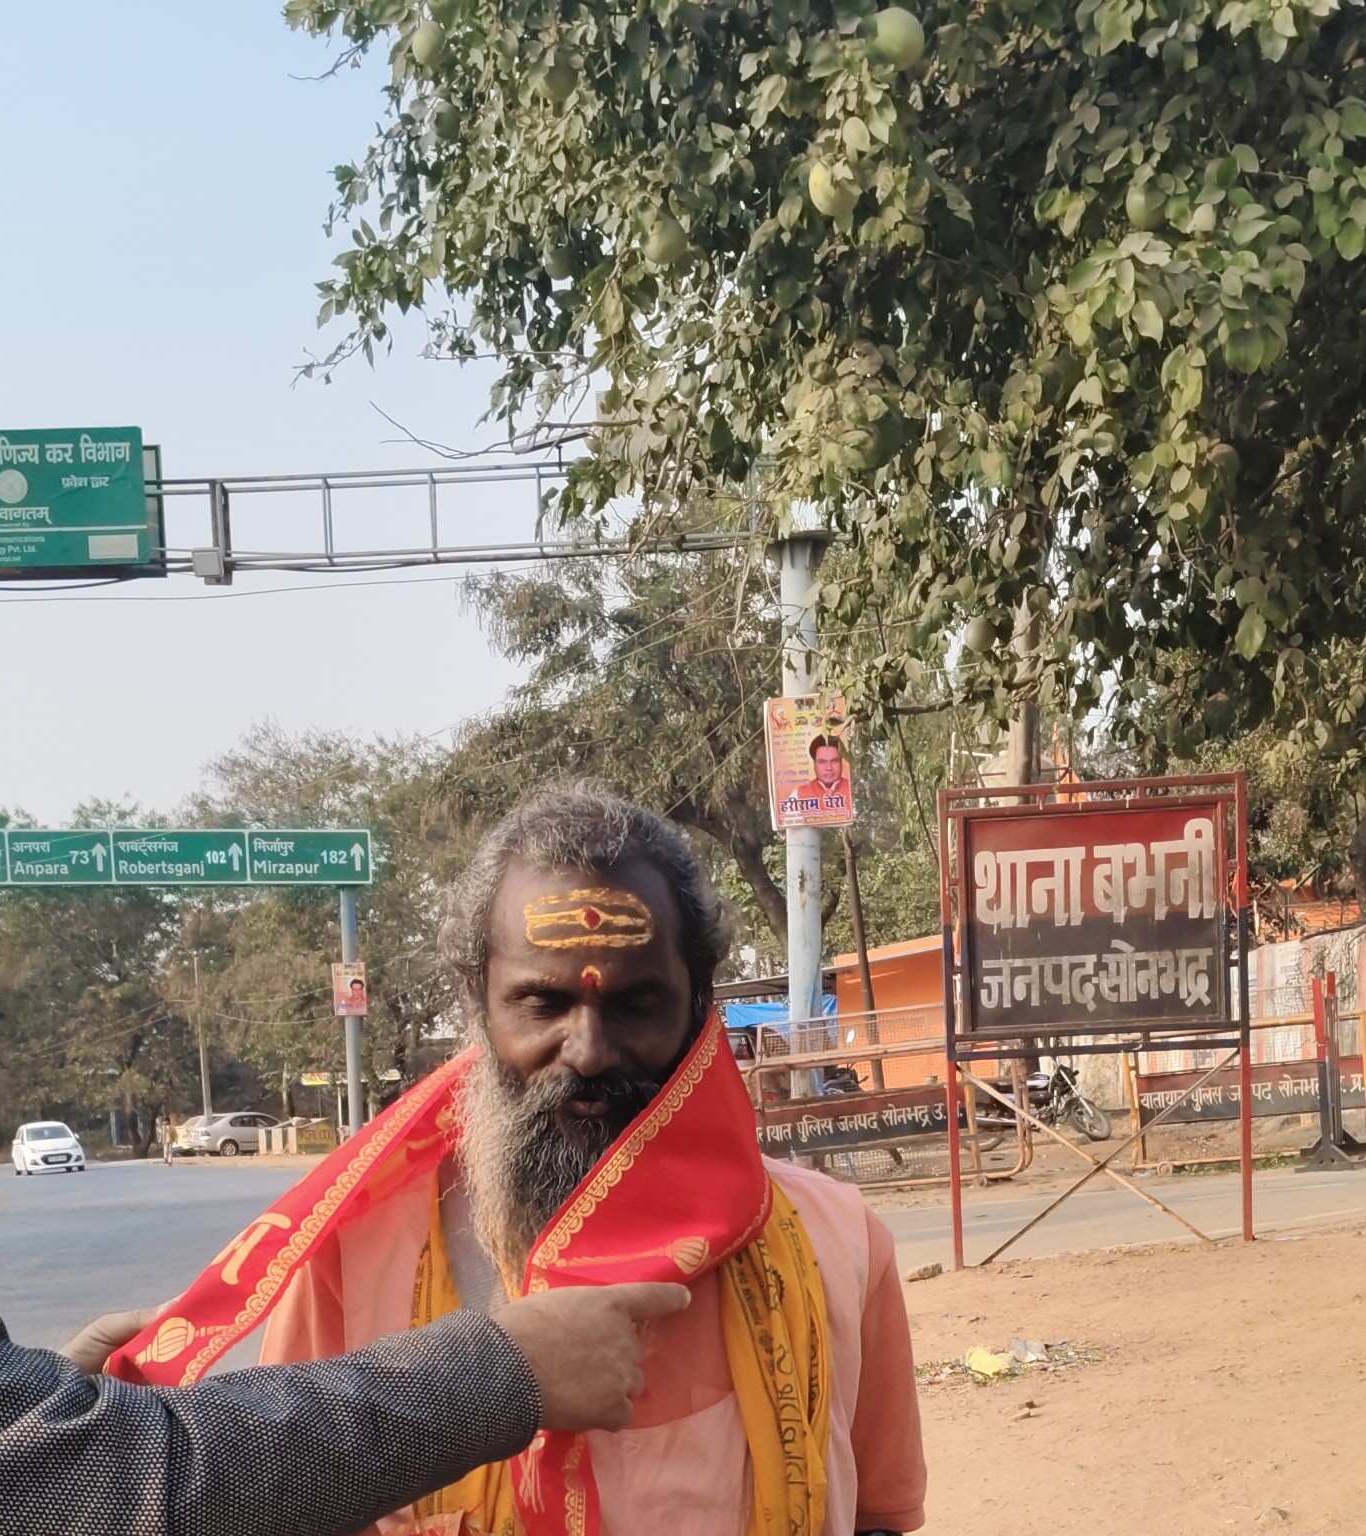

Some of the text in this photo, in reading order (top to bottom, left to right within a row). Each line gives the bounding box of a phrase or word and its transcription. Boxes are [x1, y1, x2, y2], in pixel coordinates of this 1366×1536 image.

[45, 443, 74, 465] कर
[79, 434, 131, 464] विभाग
[61, 473, 110, 489] प्रवेश द्वार
[779, 793, 845, 813] हरीराम चेरो
[12, 842, 51, 853] अनपरा
[253, 837, 295, 857] मिर्जापुर
[69, 850, 90, 865] 73
[206, 850, 227, 864] 102
[320, 850, 348, 864] 182
[14, 861, 69, 877] Anpara
[118, 861, 205, 877] Robertsganj
[253, 861, 320, 877] Mirzapur
[974, 846, 1086, 932] थाना
[1190, 1084, 1223, 1112] पुलिस
[1226, 1082, 1275, 1105] जपद
[797, 1114, 834, 1143] पुलिस
[837, 1111, 880, 1134] जनपद
[882, 1103, 933, 1127] सोनभद्र
